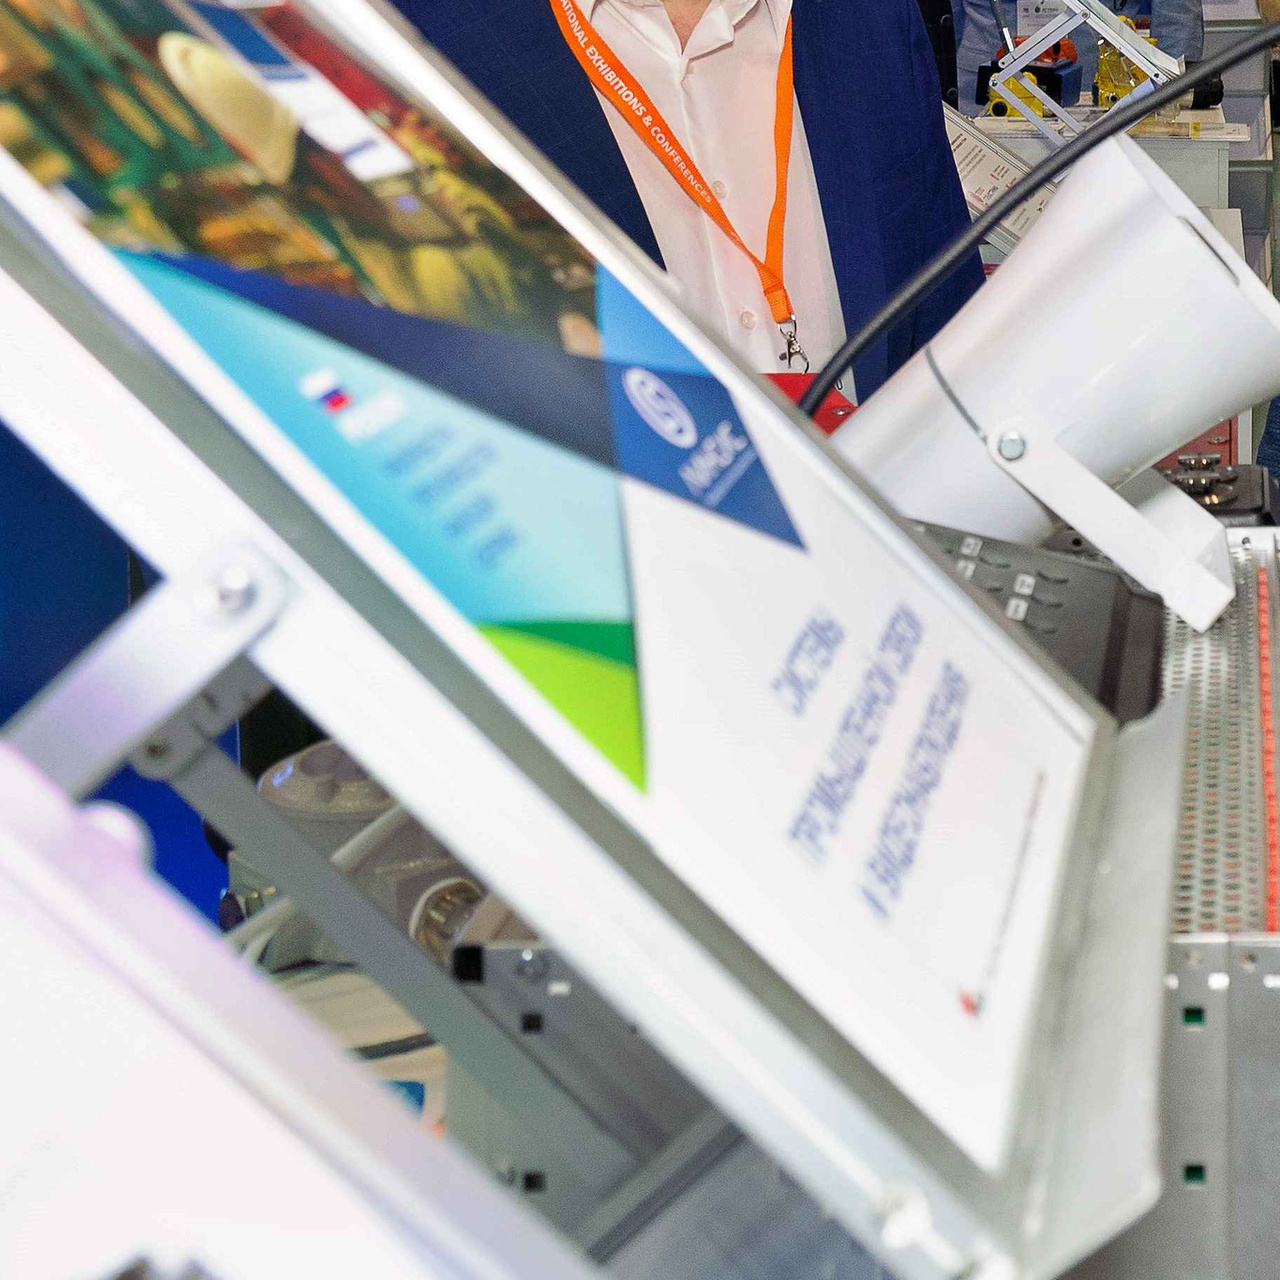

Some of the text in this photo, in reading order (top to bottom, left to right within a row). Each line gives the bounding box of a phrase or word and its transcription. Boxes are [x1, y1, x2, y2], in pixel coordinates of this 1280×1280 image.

[584, 45, 647, 117] EXHIBITIONS
[642, 114, 653, 127] &
[649, 125, 712, 204] CONFERENCES
